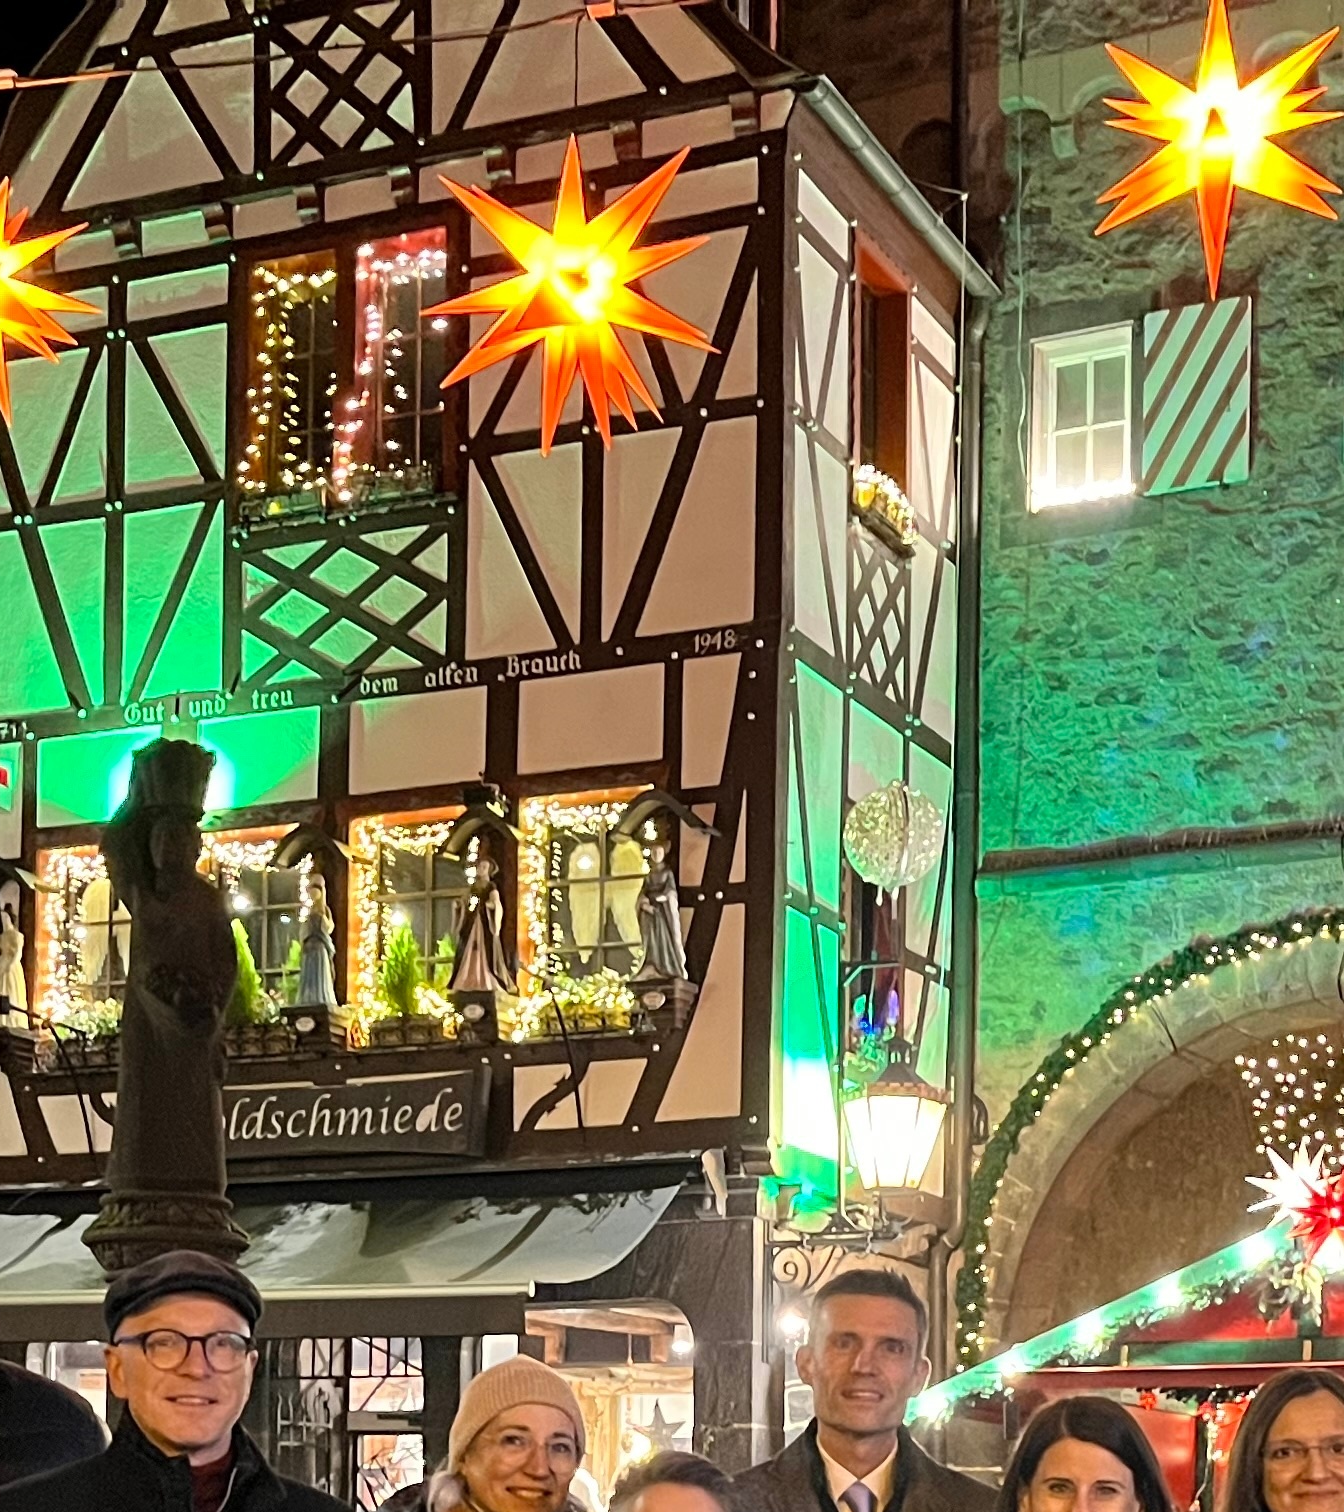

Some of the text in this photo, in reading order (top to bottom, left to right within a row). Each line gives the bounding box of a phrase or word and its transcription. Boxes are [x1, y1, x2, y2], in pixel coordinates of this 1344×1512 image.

[123, 701, 165, 725] Gut
[188, 694, 226, 718] und
[251, 688, 295, 710] treu
[359, 675, 399, 695] dem
[506, 650, 582, 678] Brauch
[694, 628, 737, 656] 1948
[222, 1087, 464, 1141] ldschmiede
